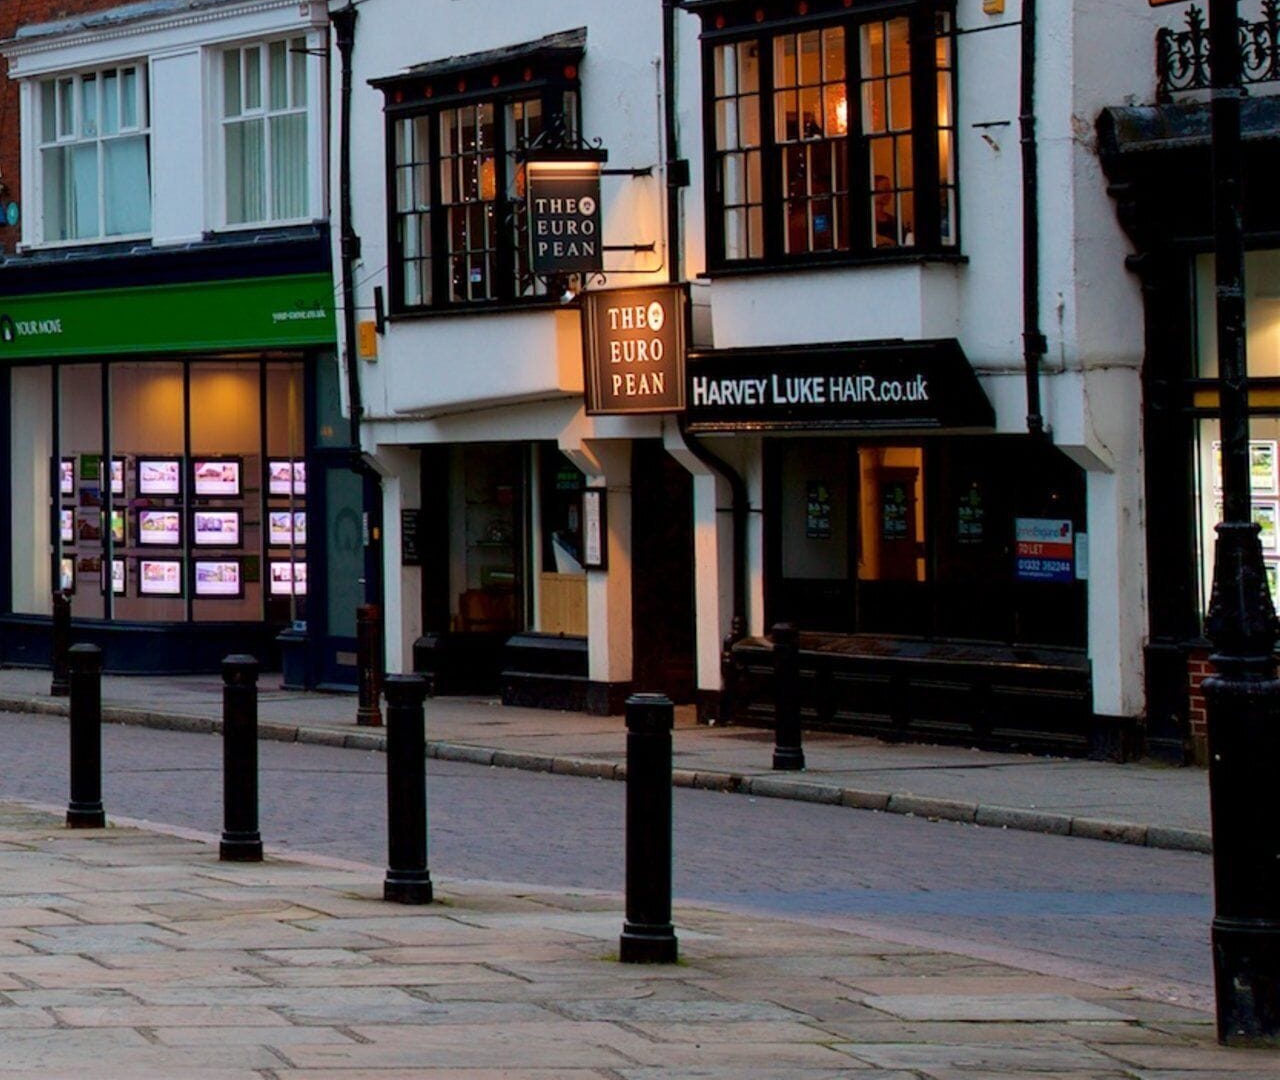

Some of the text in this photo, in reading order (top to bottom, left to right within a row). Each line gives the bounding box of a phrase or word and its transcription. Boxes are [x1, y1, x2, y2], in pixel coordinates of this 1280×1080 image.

[535, 198, 577, 214] THE
[537, 220, 594, 236] EURO
[538, 241, 595, 257] PEAN
[15, 318, 63, 335] YOUR MOVE
[608, 306, 647, 330] THE
[610, 338, 663, 363] EURO
[612, 372, 665, 396] PEAN
[693, 374, 929, 406] HARVEY LUKE HAIR.co.uk
[1019, 543, 1043, 555] TO LET
